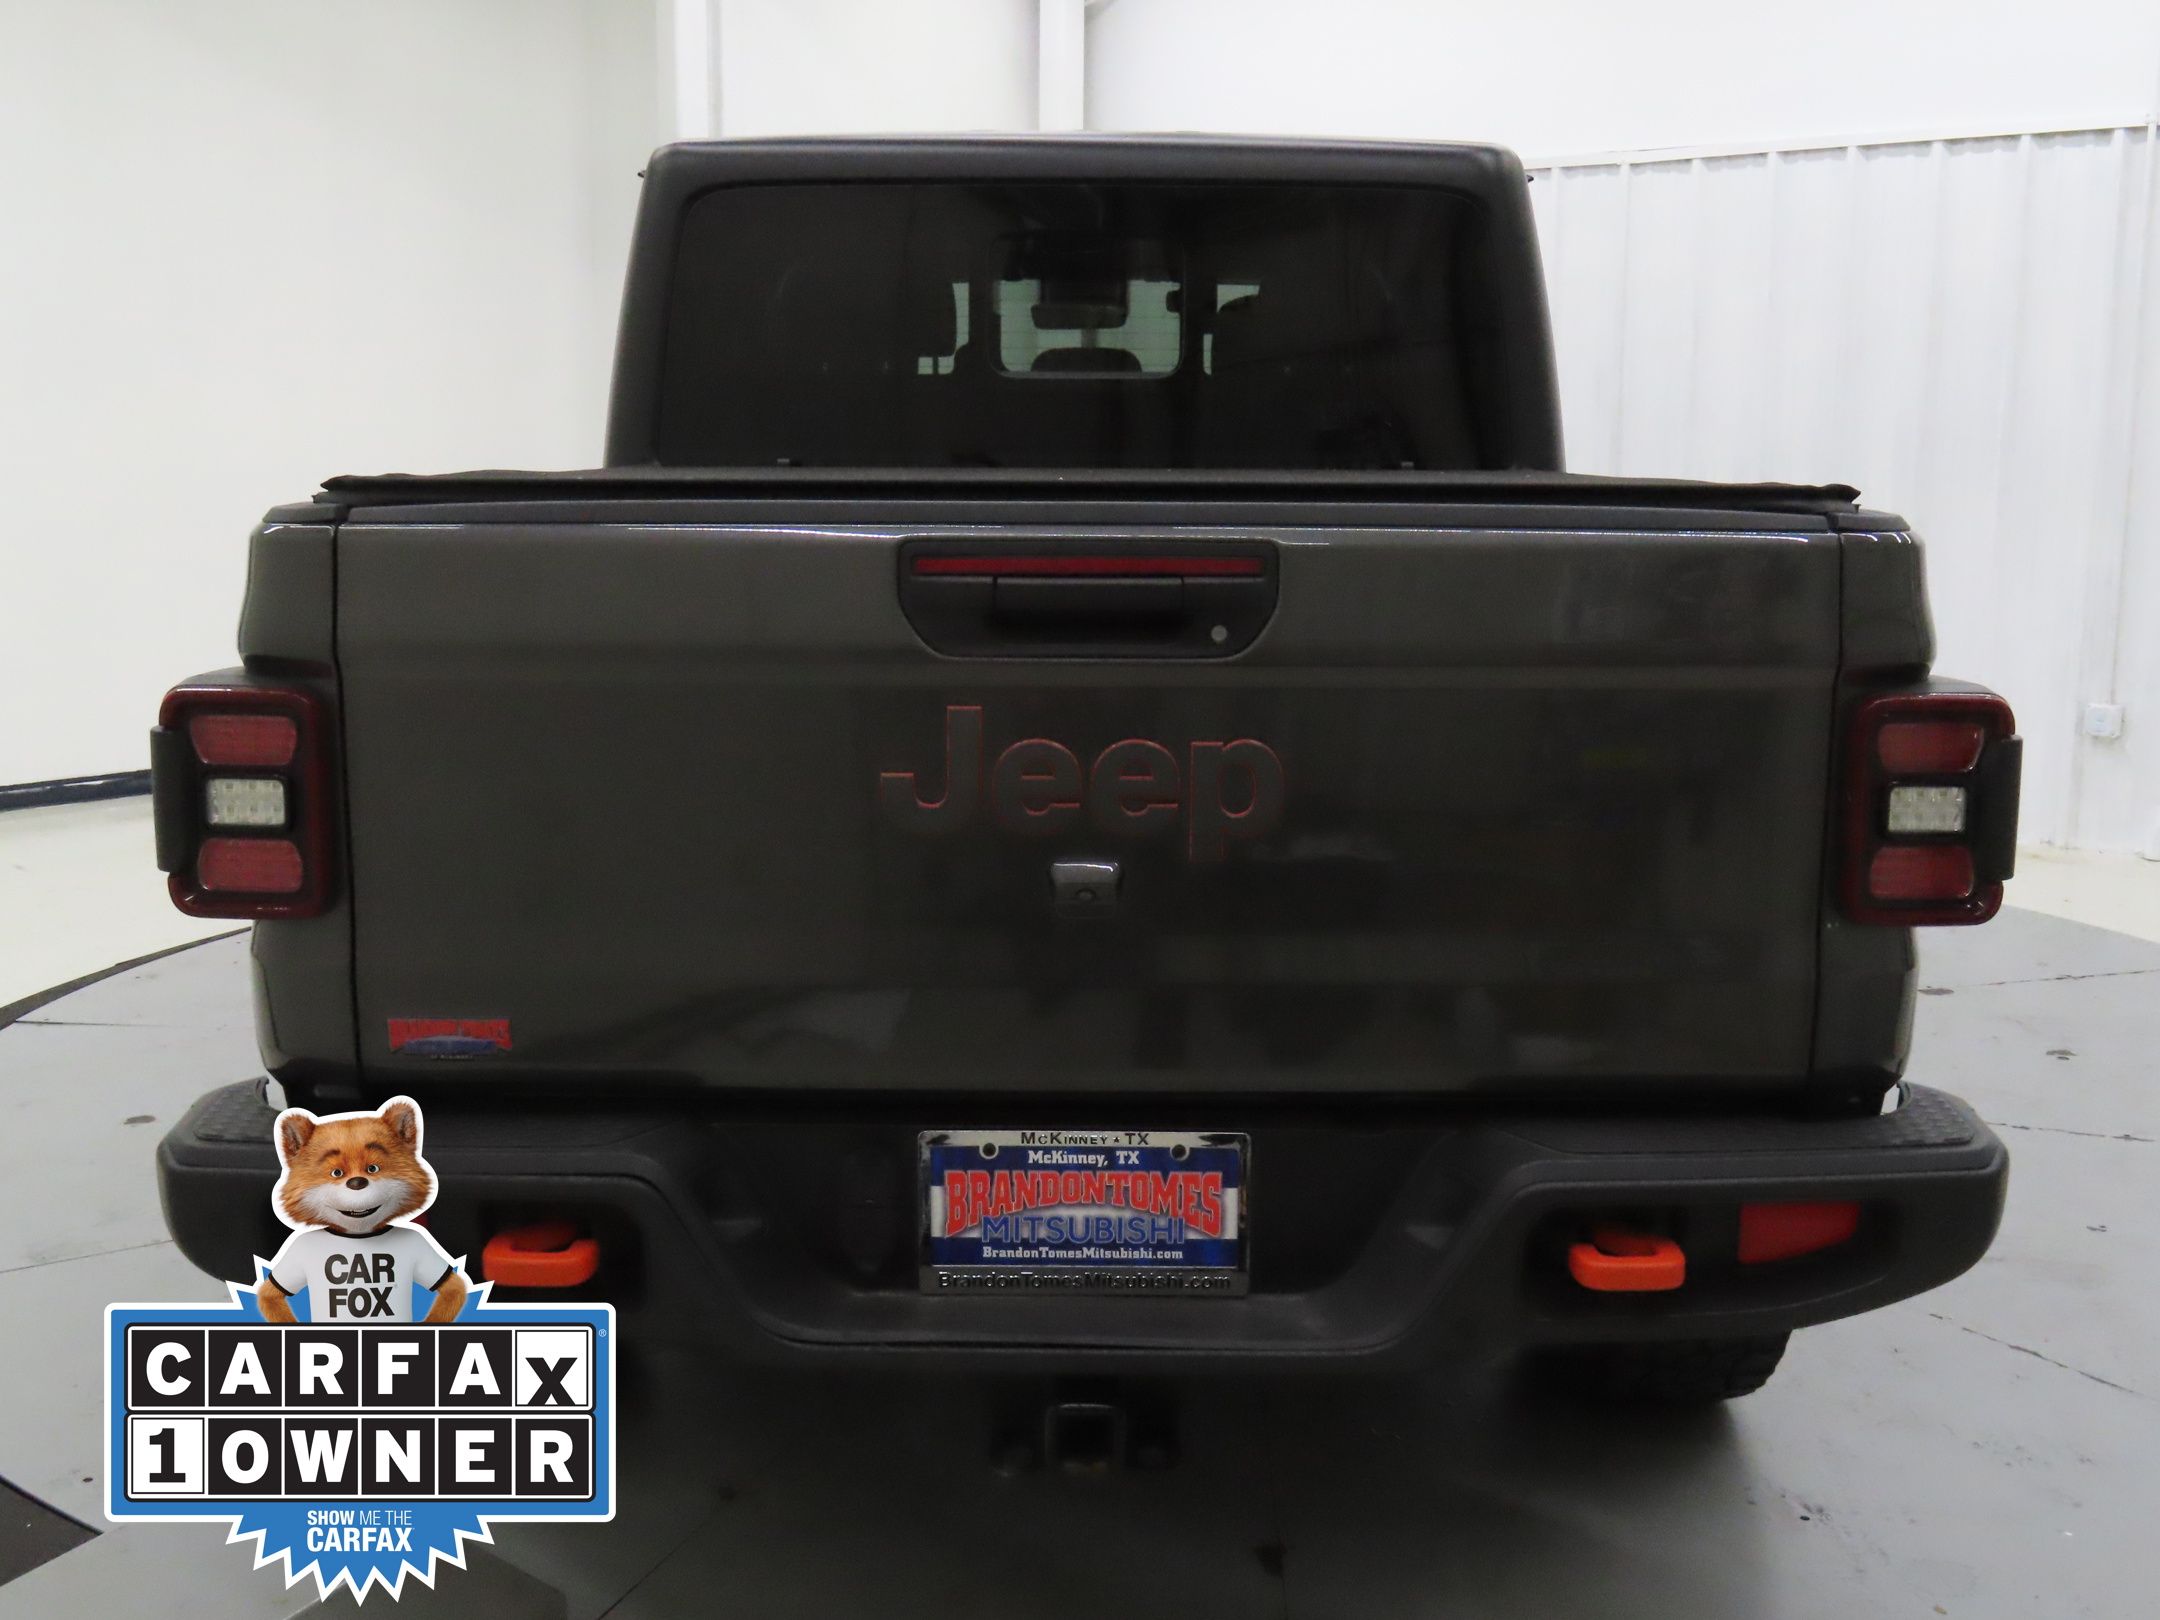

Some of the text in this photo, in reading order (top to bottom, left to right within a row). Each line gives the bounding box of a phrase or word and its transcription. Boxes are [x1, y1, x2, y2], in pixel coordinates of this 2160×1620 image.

[880, 704, 1286, 864] Jeep
[1125, 1132, 1149, 1146] TX
[1027, 1150, 1140, 1167] McKinney, TX
[944, 1169, 1222, 1237] BRANDONTOMES
[981, 1215, 1185, 1244] MITSUBISHI
[982, 1246, 1183, 1260] BrandonTomesMitsubishi.com
